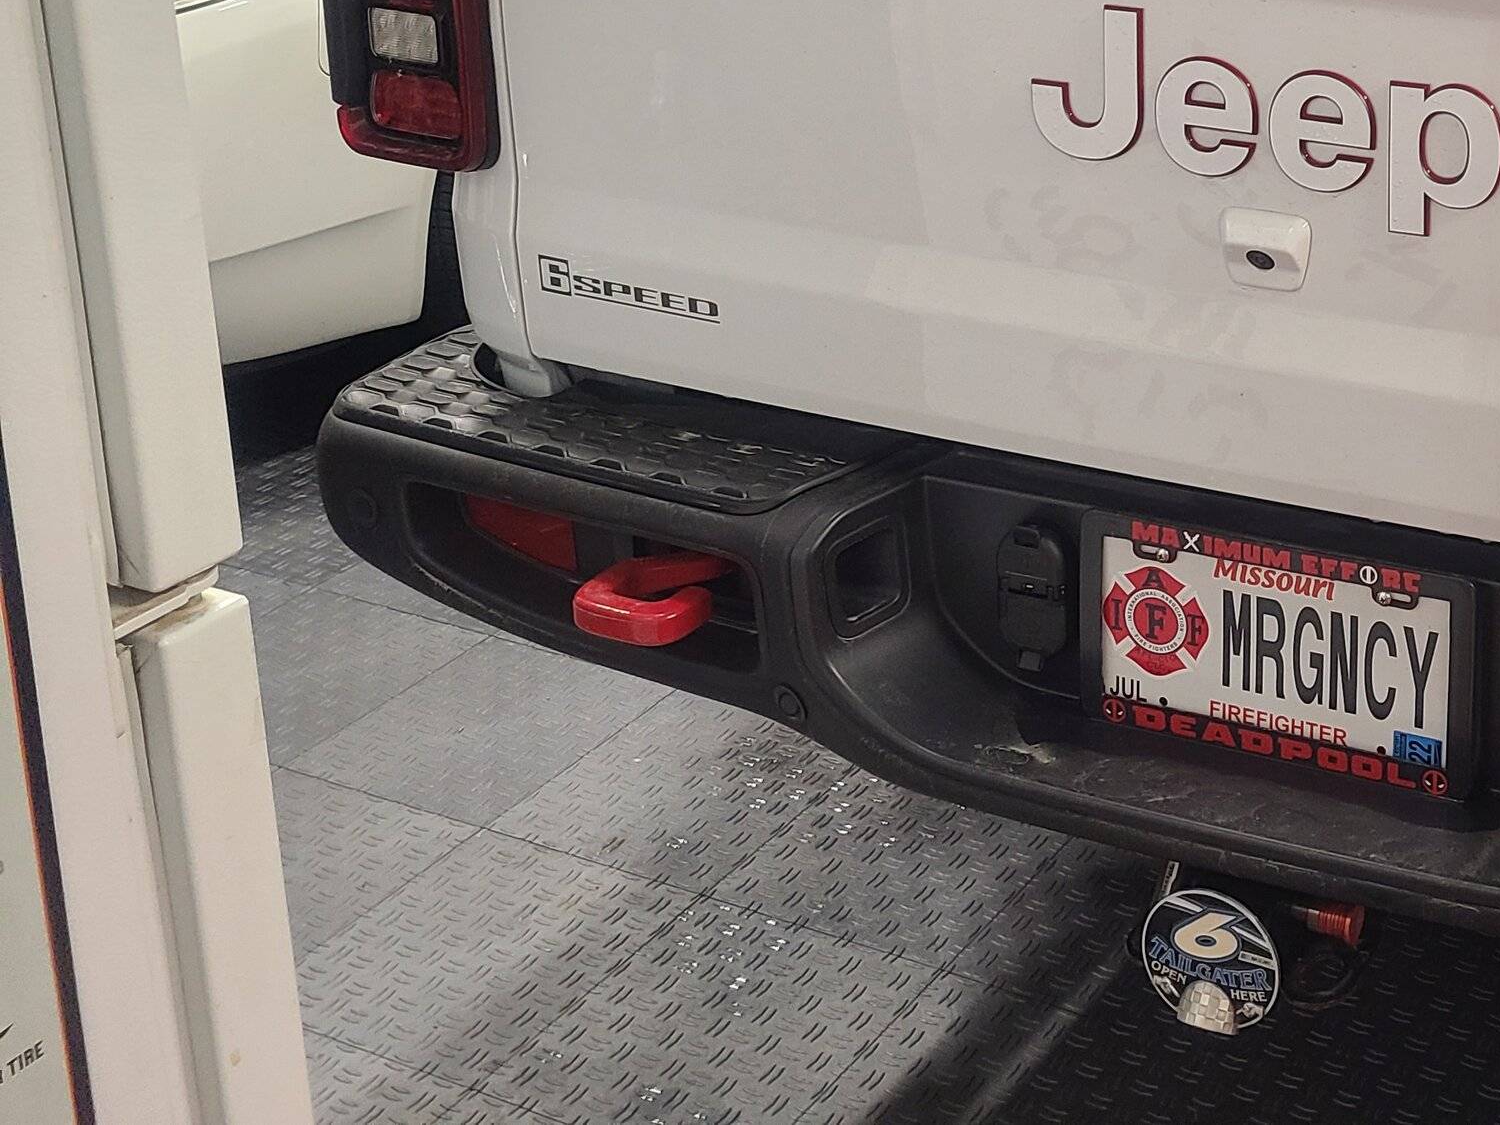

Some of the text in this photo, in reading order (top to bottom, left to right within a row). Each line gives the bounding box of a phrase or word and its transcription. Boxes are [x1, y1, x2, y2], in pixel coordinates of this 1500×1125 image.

[1131, 520, 1293, 571] MAXIMUM
[1142, 569, 1165, 589] A
[1213, 557, 1336, 602] Missouri
[1110, 598, 1206, 646] I F F
[1221, 588, 1440, 730] MRGNCY
[1110, 675, 1148, 703] JUL
[1208, 700, 1349, 746] FIREFIGHTER
[1130, 704, 1417, 789] DEADPOOL
[1407, 740, 1433, 765] 22
[1171, 909, 1241, 963] 6
[1149, 935, 1273, 992] TAILGATER
[1149, 960, 1188, 986] OPEN
[1230, 987, 1268, 1003] HERE
[6, 1039, 46, 1077] TIRE
